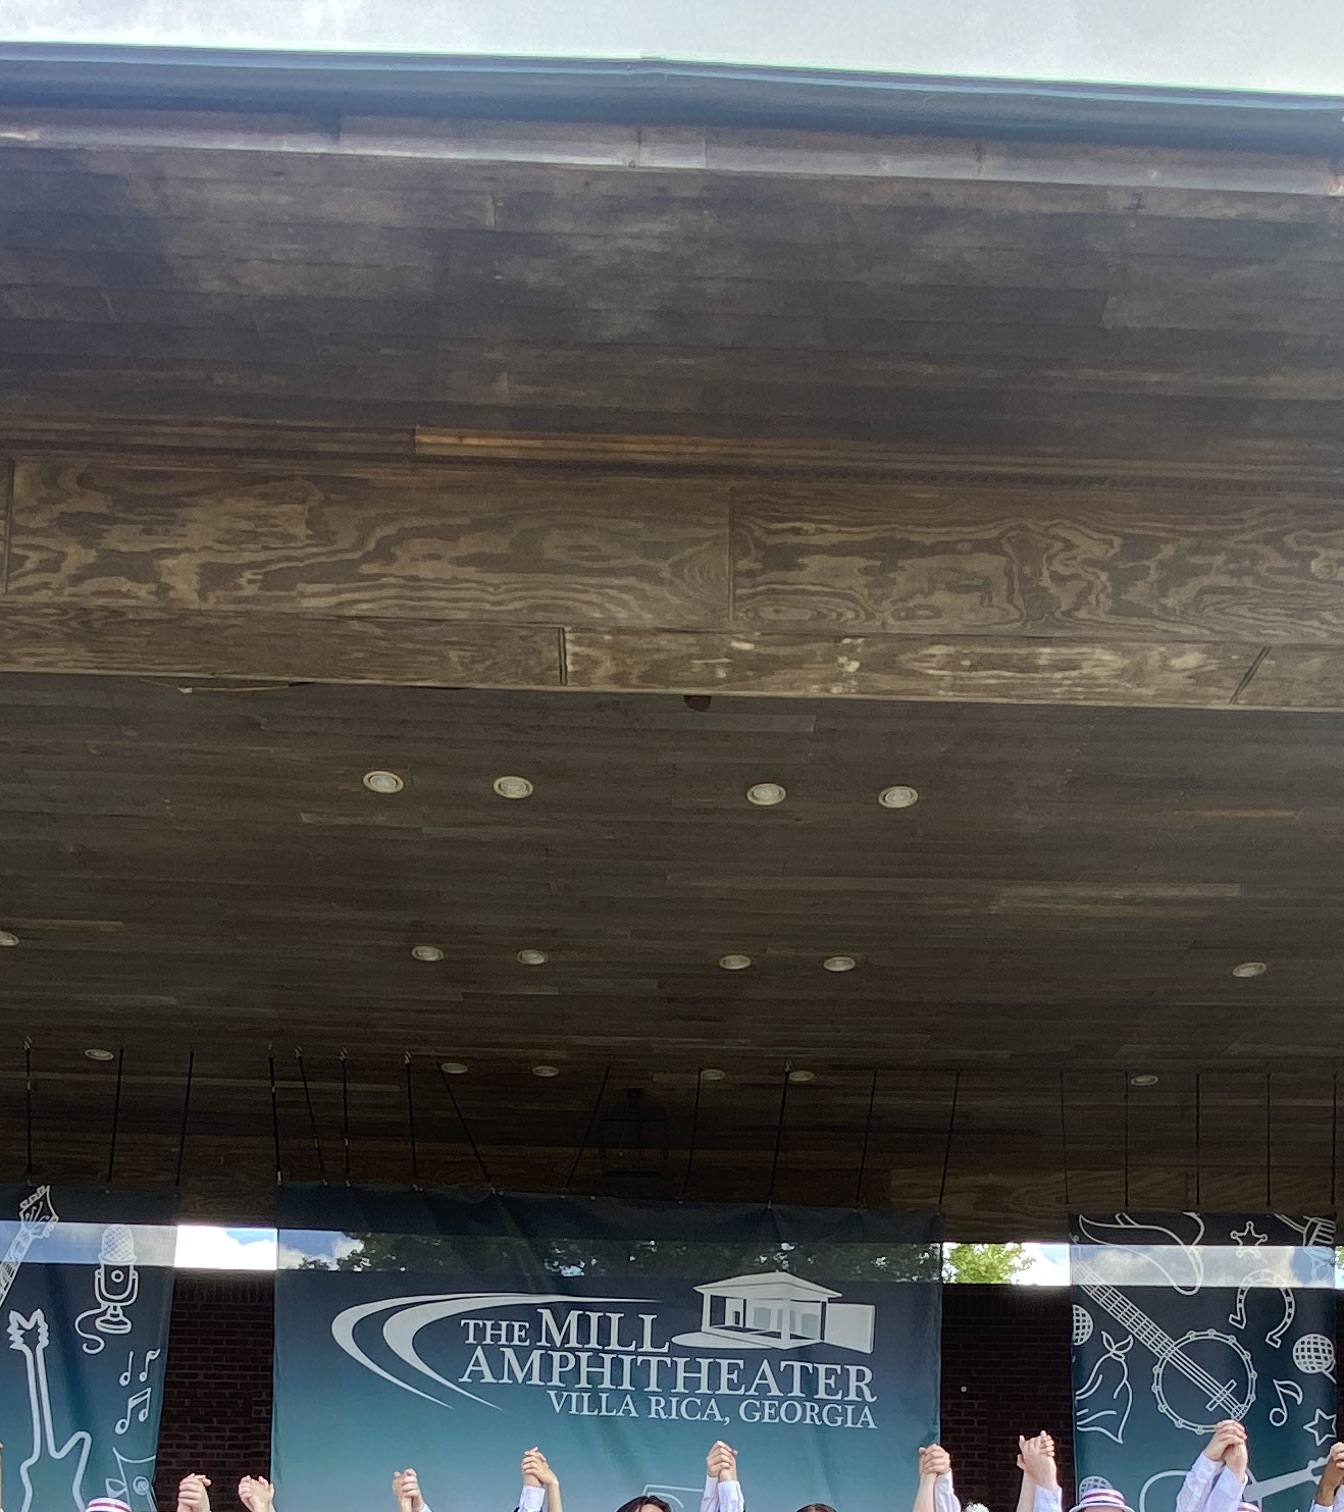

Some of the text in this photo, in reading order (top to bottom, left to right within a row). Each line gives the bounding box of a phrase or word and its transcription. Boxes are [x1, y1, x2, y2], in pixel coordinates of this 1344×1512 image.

[460, 1308, 670, 1353] THE MILL
[458, 1345, 878, 1403] AMPHITHEATER
[546, 1389, 878, 1430] VILLA RICA, GEORGIA
